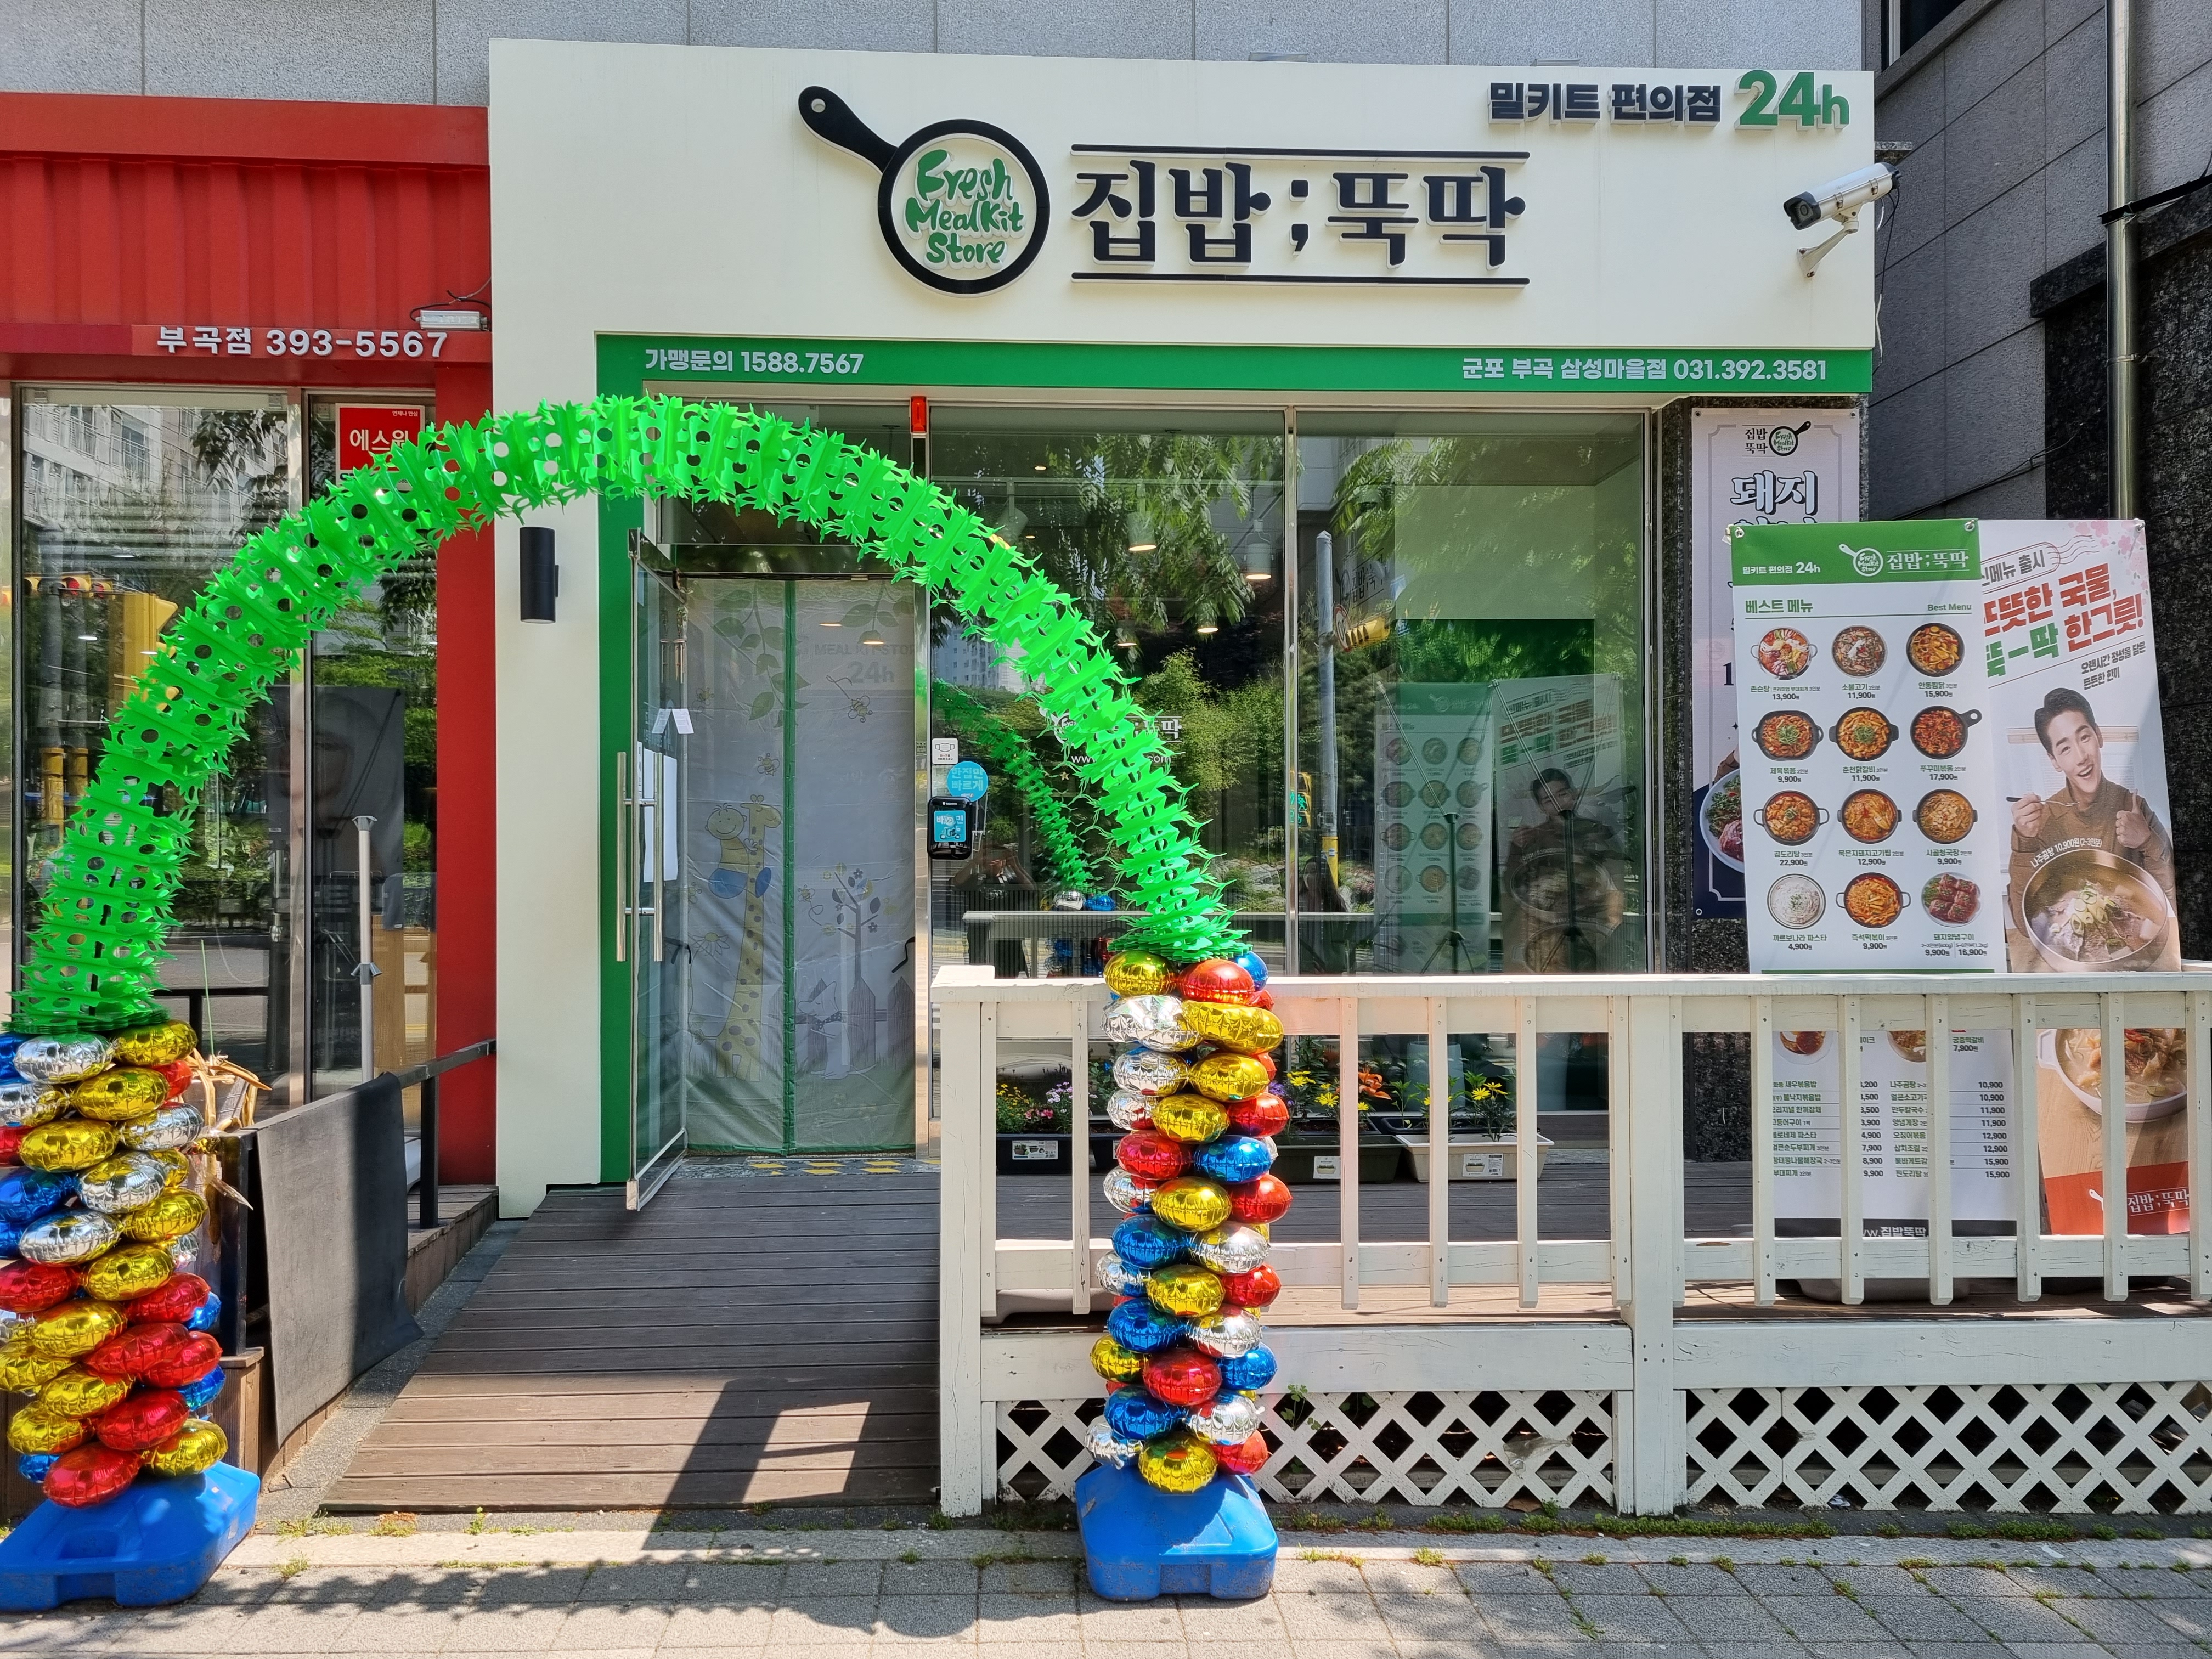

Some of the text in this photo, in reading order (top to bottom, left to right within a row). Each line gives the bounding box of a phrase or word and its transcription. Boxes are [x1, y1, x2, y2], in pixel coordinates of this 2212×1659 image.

[1489, 70, 1850, 130] 밀키트 편의점 24h
[916, 149, 1014, 204] Fresh
[925, 231, 1006, 266] Store
[157, 326, 448, 358] 부곡점 393-5567
[645, 349, 864, 374] 가맹문의 1588.7567
[1462, 358, 1827, 381] 군포 부곡 삼성마을점 031.392.3581
[1745, 428, 1768, 440] 집밥
[1745, 442, 1768, 454] 뚝딱
[1730, 470, 1818, 516] 돼지
[1742, 561, 1821, 574] 밀키트 편의점 24h
[2018, 550, 2045, 574] 출시
[1745, 599, 1813, 614] 베스트 메뉴
[2064, 593, 2144, 653] 한그릇!
[2081, 641, 2146, 675] 오랜시간 정성을 담은
[848, 661, 895, 684] 24h
[2083, 666, 2120, 691] 든든한 한끼
[951, 767, 985, 779] 한집만
[951, 780, 984, 791] 빠르게
[1982, 1132, 2007, 1141] 12,900
[1983, 1145, 2008, 1153] 12,900
[1862, 1157, 1883, 1165] 8,900
[1985, 1171, 2010, 1179] 15,900
